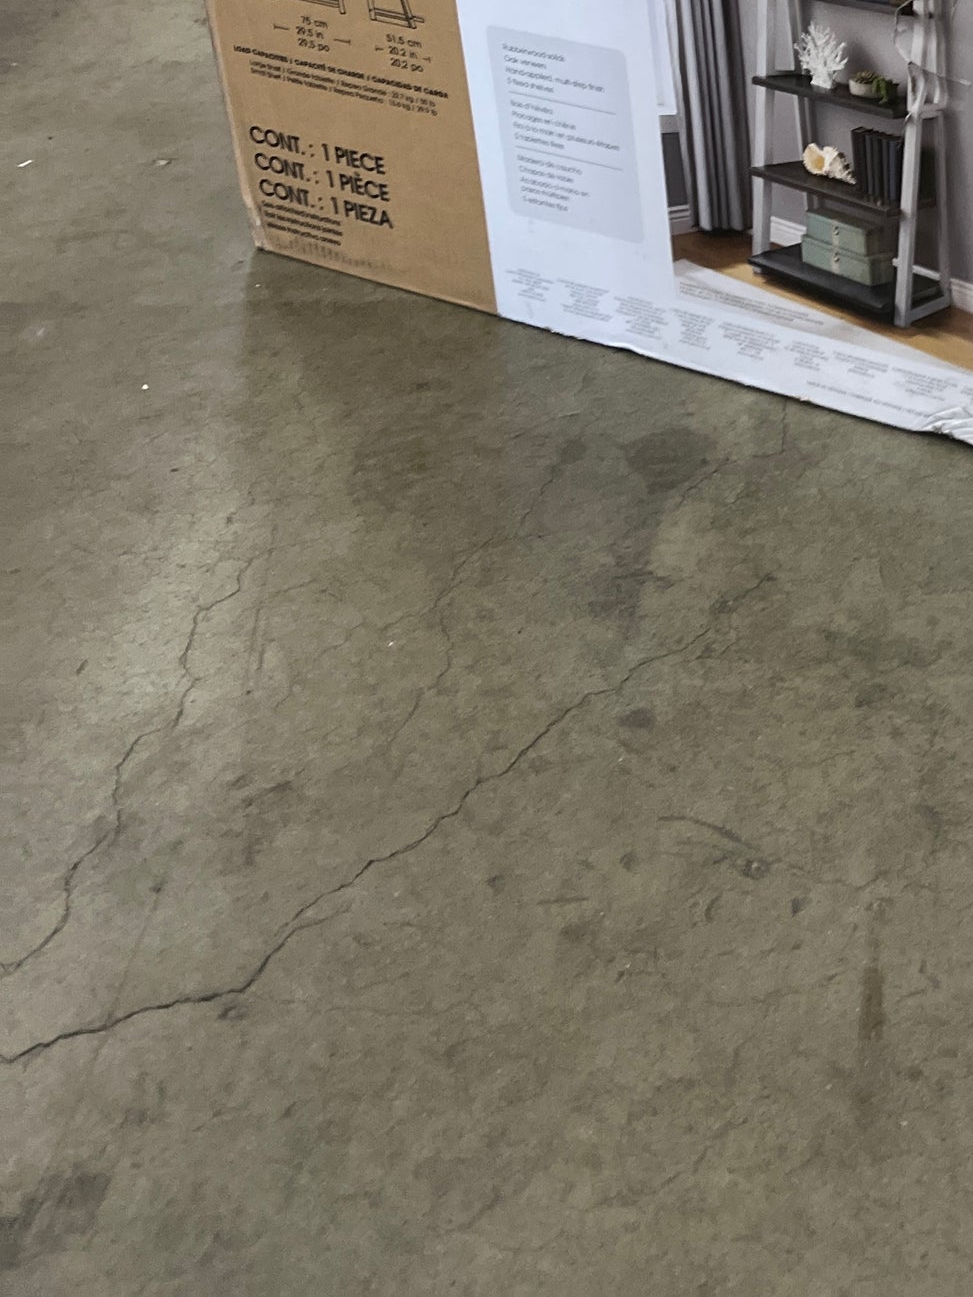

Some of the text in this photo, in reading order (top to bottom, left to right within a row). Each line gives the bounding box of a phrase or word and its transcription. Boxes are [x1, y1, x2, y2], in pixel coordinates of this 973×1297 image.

[301, 15, 328, 30] 75 cm
[386, 33, 423, 49] 51.5 cm
[388, 45, 419, 60] 20.2 in
[390, 57, 409, 70] 20.2
[321, 143, 330, 161] 1
[335, 146, 386, 175] PIECE
[326, 170, 334, 188] 1
[339, 170, 390, 202] PIÈCE
[330, 196, 338, 214] 1
[344, 200, 394, 230] PIEZA
